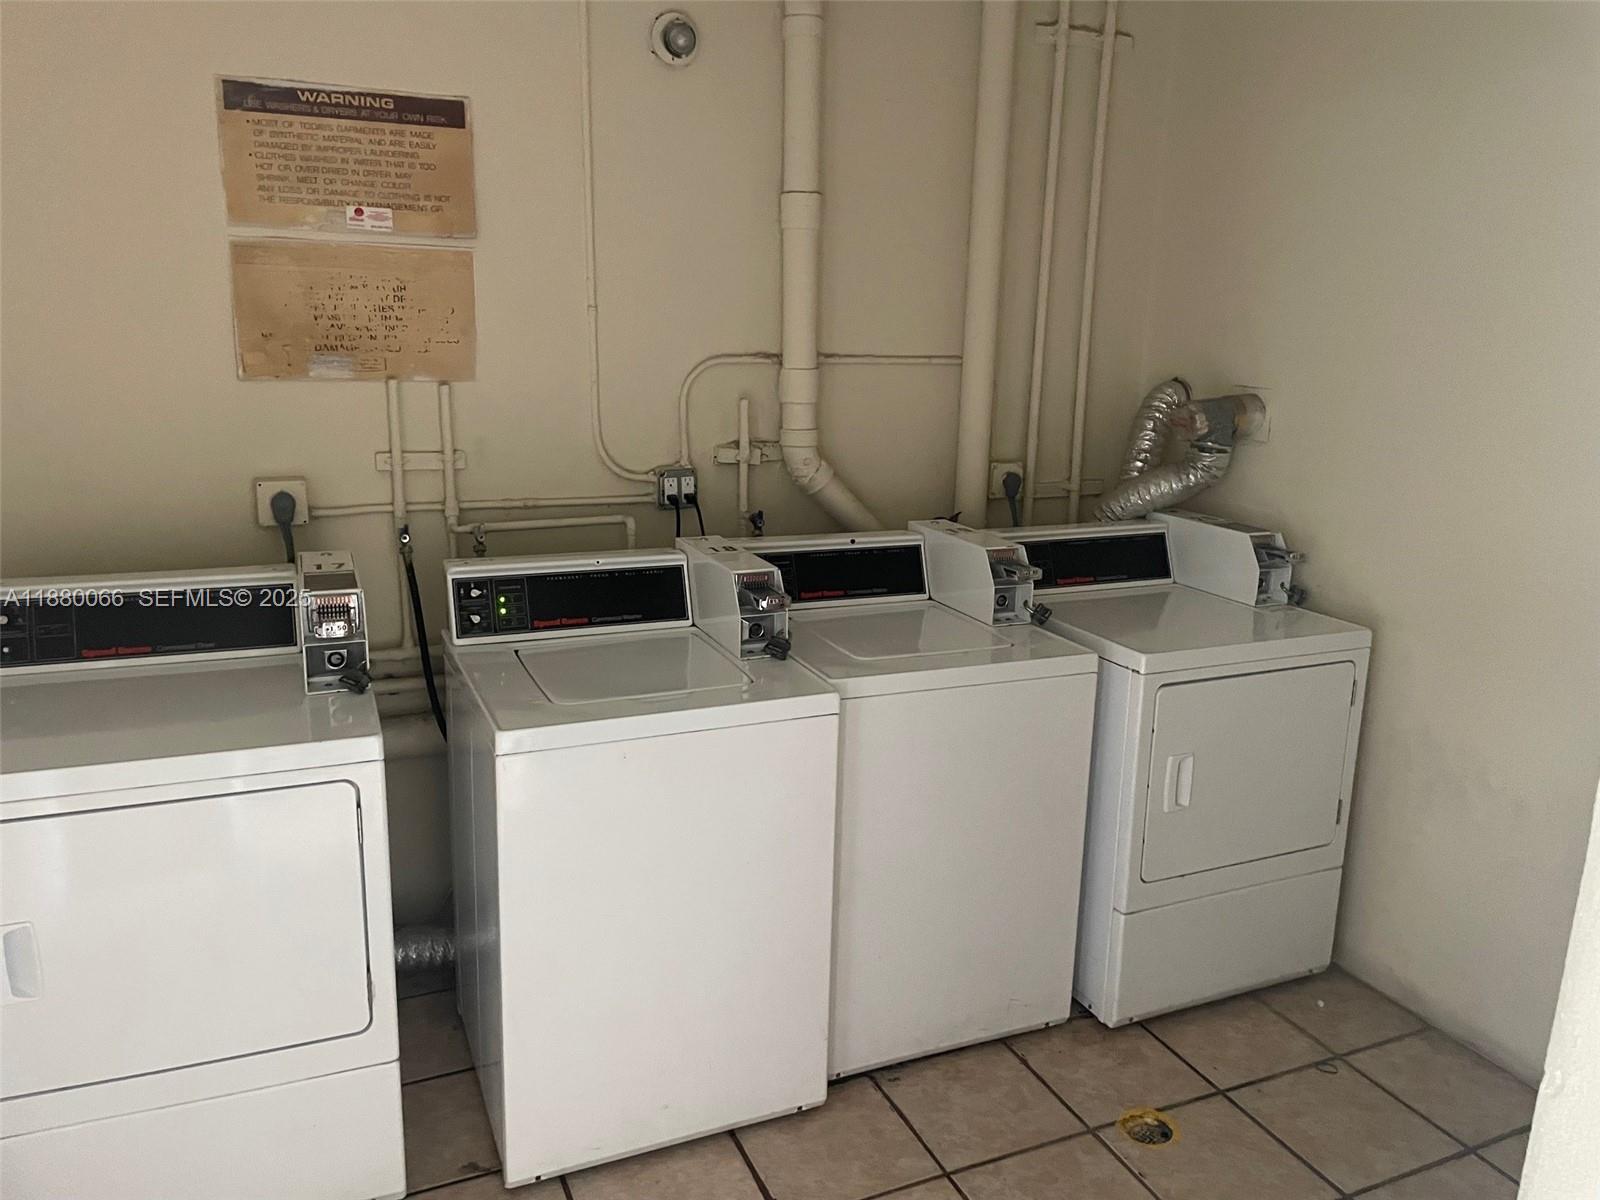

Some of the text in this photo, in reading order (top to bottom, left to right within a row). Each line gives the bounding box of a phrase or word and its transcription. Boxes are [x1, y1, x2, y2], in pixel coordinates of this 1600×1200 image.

[297, 90, 394, 109] WARNING
[266, 101, 311, 112] WASHERS
[321, 106, 358, 116] DRYERS
[360, 109, 370, 117] AT
[372, 110, 398, 119] YOUR
[402, 112, 424, 121] OWN
[427, 115, 447, 124] RISK
[252, 119, 278, 127] MOST
[282, 120, 293, 128] OF
[336, 124, 386, 136] GARMENTS
[389, 130, 407, 138] ARE
[410, 131, 434, 140] MADE
[253, 129, 437, 150] OF SYNTHETIC MATERIAL AND ARE EASILY
[254, 141, 298, 151] DAMAGED
[316, 145, 362, 156] IMPROPER
[254, 151, 296, 161] CLOTHES
[298, 155, 338, 164] WASHED
[353, 158, 382, 168] WATER
[385, 160, 405, 169] THAT
[418, 162, 436, 171] TOO
[256, 162, 273, 170] HOT
[278, 164, 291, 172] OR
[351, 168, 360, 176] IN
[362, 169, 391, 178] DRYER
[394, 171, 413, 179] MAY
[297, 175, 318, 184] MELT
[323, 177, 336, 185] OR
[341, 178, 376, 188] CHANGE
[257, 184, 451, 203] ANY LOSS OR DAMAGE TO CLOTHING IS NOT
[257, 194, 276, 202] THE
[278, 196, 350, 207] RESPONSIBILITY
[367, 202, 428, 212] MANAGEMENT
[430, 204, 443, 213] OR
